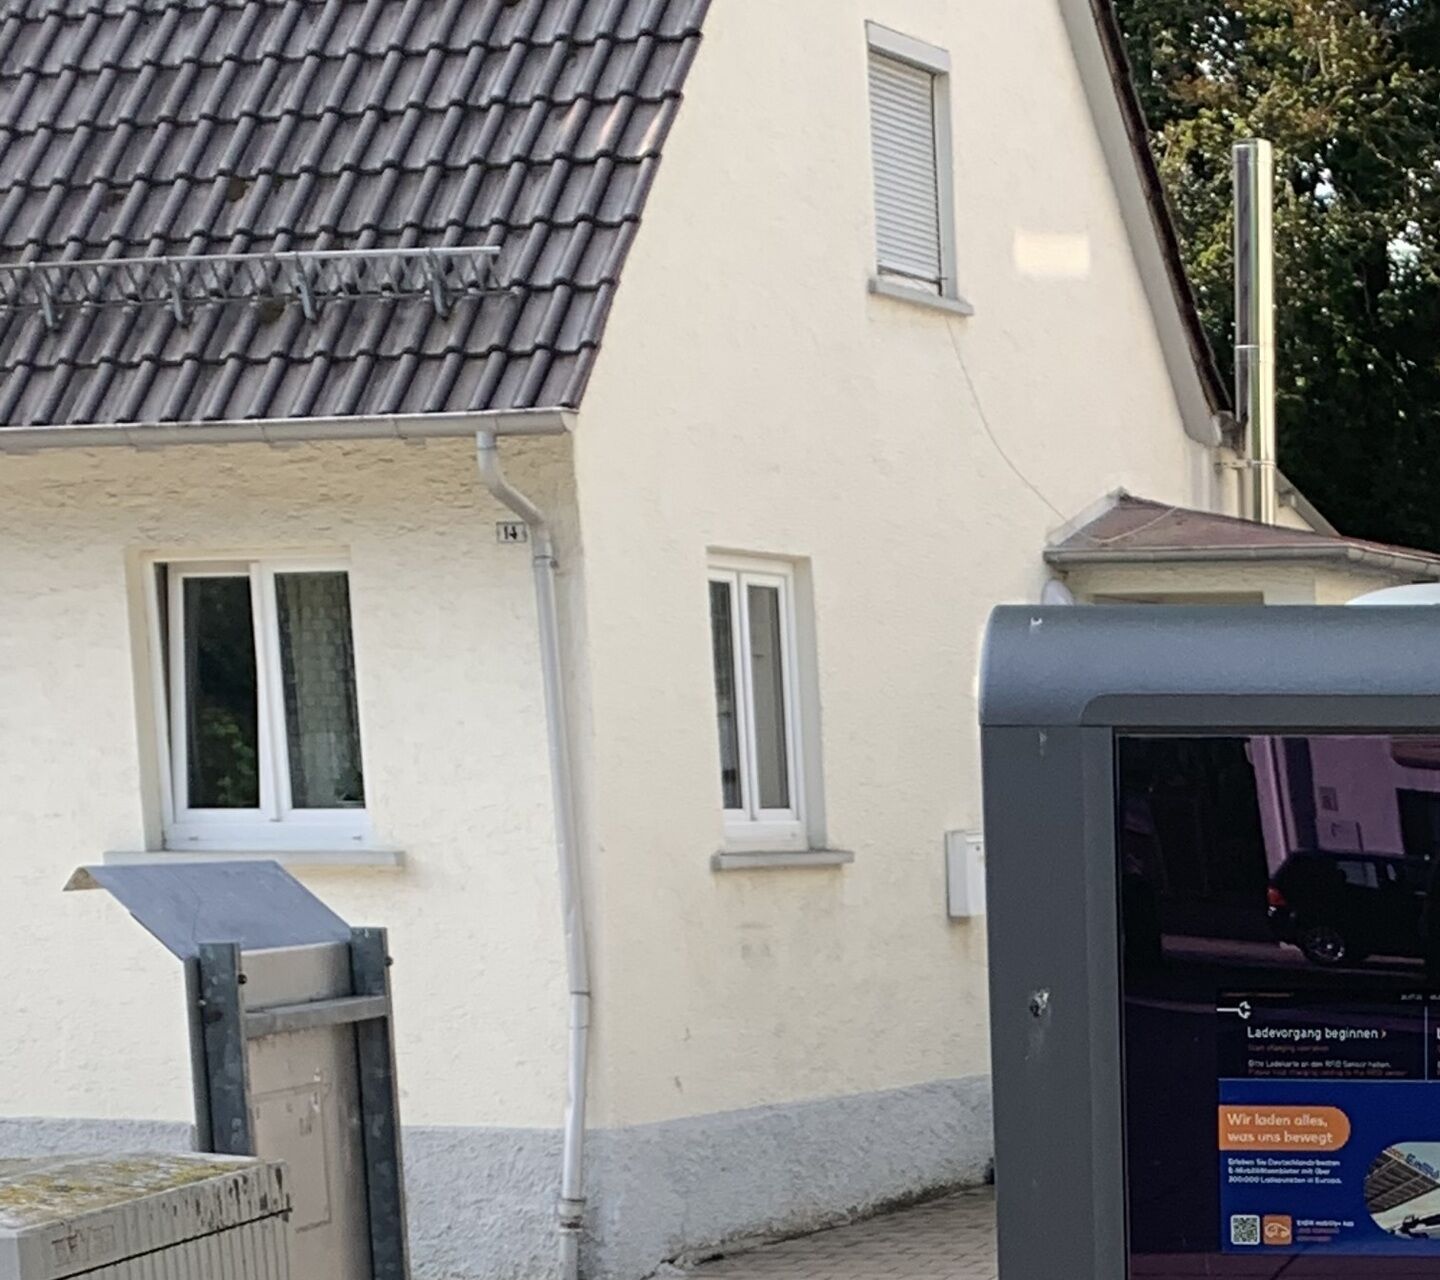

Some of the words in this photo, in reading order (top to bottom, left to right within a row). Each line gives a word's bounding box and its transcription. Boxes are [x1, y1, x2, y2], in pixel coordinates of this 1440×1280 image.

[504, 525, 518, 540] 14
[1247, 1026, 1321, 1041] Ladevorgang
[1325, 1027, 1378, 1041] beginnen
[1226, 1113, 1252, 1126] Wir
[1255, 1113, 1291, 1126] laden
[1294, 1113, 1328, 1127] alles,
[1227, 1132, 1255, 1142] was
[1258, 1132, 1280, 1143] uns
[1284, 1131, 1333, 1145] bewegt
